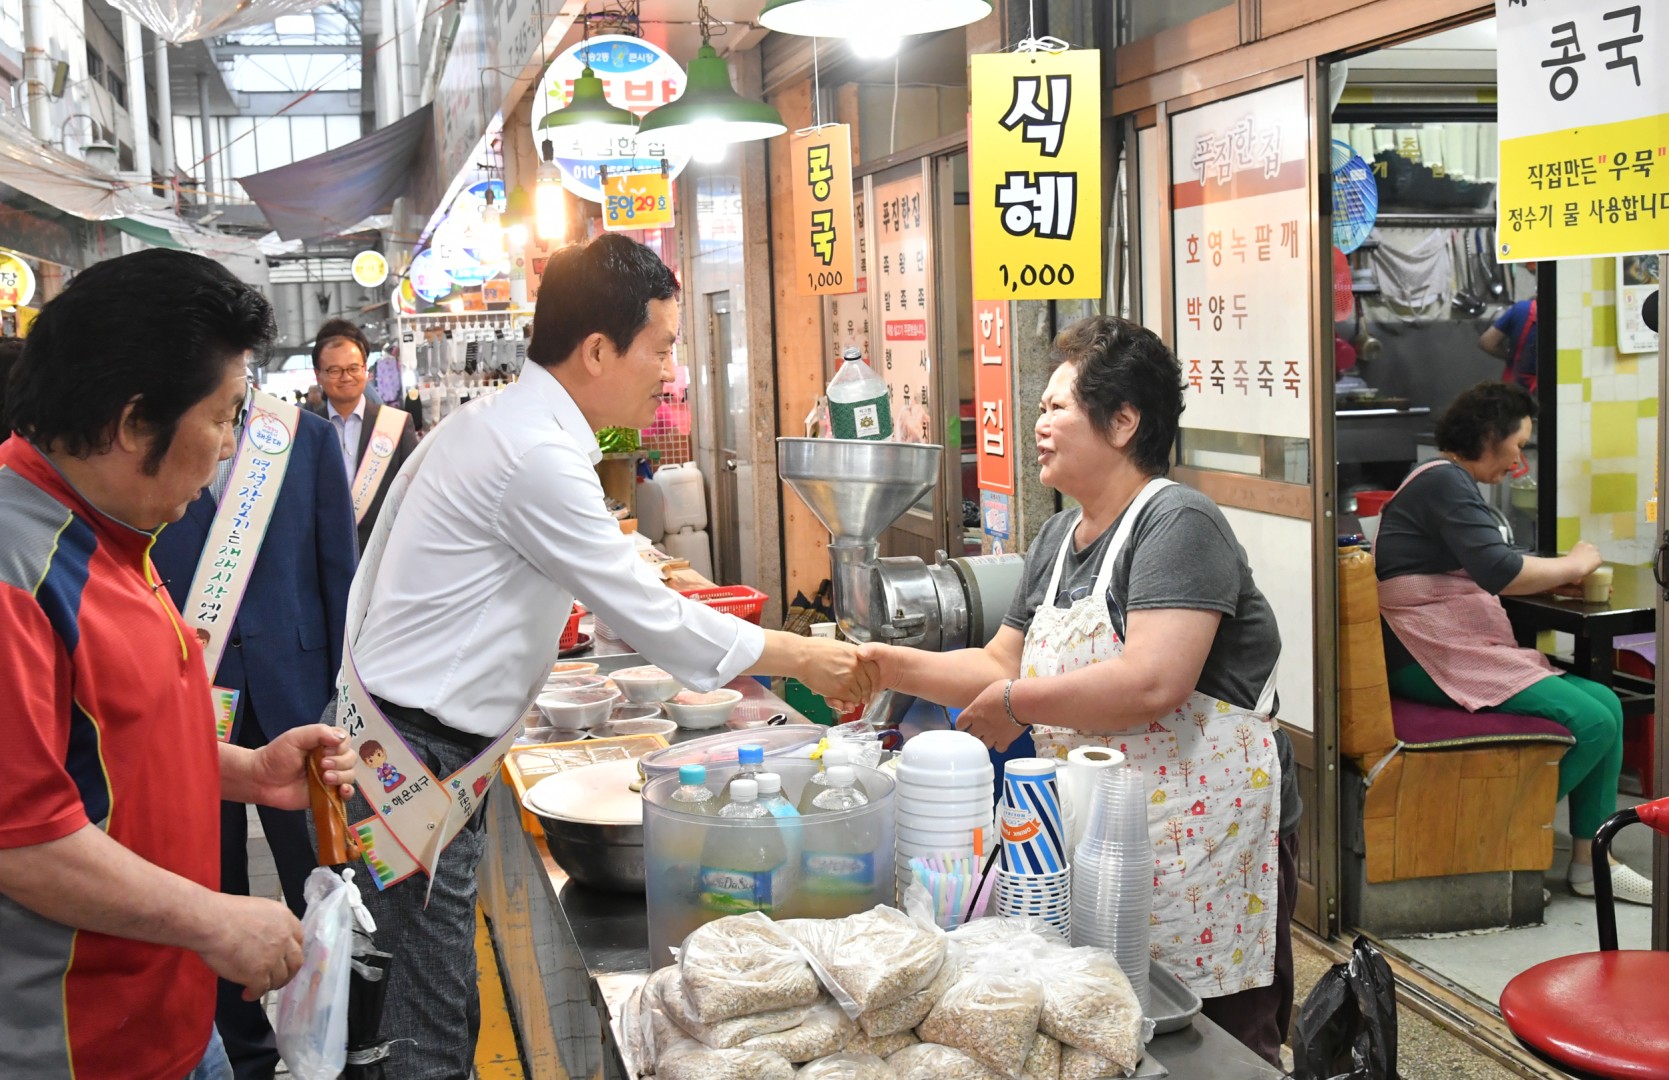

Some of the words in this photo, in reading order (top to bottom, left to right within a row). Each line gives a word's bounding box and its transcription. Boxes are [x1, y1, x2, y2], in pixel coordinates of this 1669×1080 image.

[1541, 5, 1644, 101] 콩국
[995, 74, 1077, 240] 식혜
[1194, 119, 1256, 184] 푸짐한
[1259, 125, 1281, 176] 집
[1528, 157, 1597, 191] 직접만든
[808, 143, 837, 266] 콩국
[1508, 204, 1553, 232] 정수기
[1563, 202, 1579, 227] 물
[808, 271, 843, 291] 1,000
[999, 264, 1075, 292] 1,000
